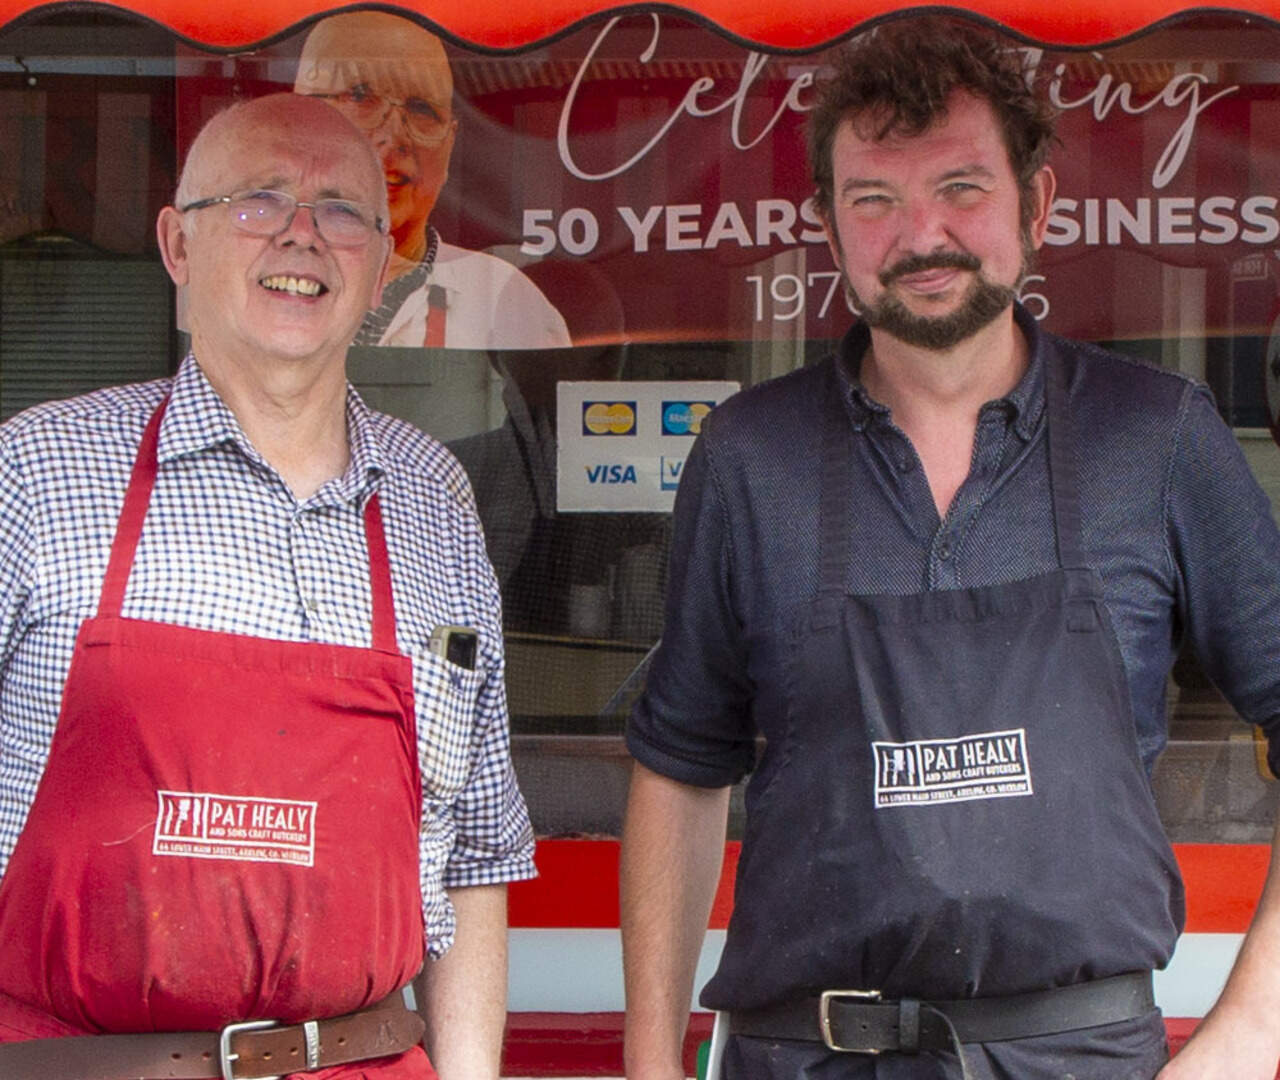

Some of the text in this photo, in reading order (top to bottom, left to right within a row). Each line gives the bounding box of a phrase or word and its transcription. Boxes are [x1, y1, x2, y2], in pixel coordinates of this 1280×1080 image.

[520, 208, 599, 256] 50
[1043, 195, 1280, 246] SINESS
[746, 270, 862, 322] 197
[585, 464, 637, 484] VISA
[924, 737, 1017, 771] PAT HEALY
[925, 772, 941, 782] AND
[942, 770, 962, 781] SONS
[962, 767, 985, 778] CRAFT
[211, 802, 308, 831] PAT HEALY
